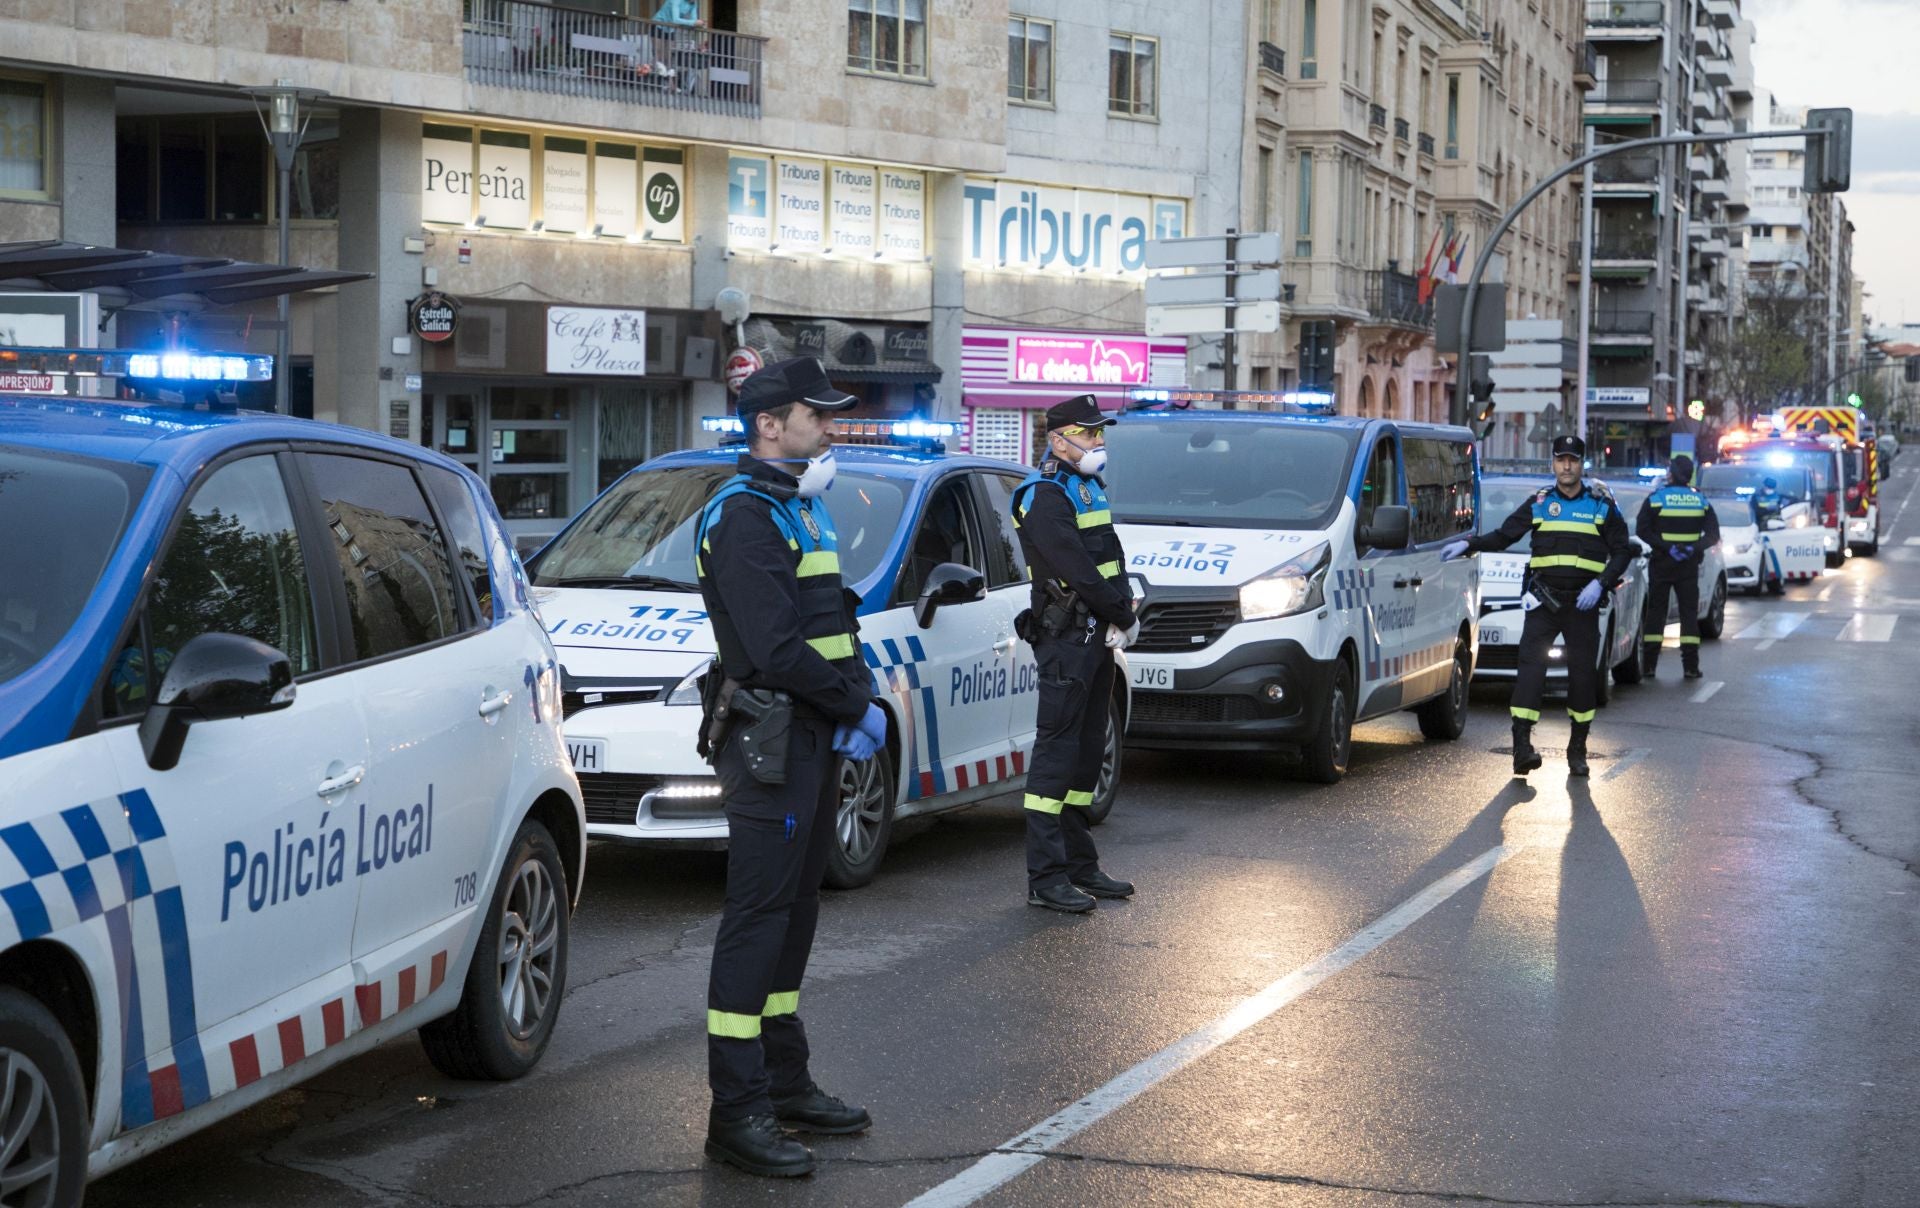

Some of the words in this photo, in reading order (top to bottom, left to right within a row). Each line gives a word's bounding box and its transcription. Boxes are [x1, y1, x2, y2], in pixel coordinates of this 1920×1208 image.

[425, 159, 526, 200] Pereña
[781, 164, 820, 181] Tribuna
[834, 170, 872, 186] Tribuna
[884, 174, 921, 191] Tribuna
[781, 194, 820, 211] Tribuna
[834, 200, 872, 216] Tribuna
[884, 204, 921, 220] Tribuna
[728, 223, 766, 238] Tribuna
[780, 226, 819, 241] Tribuna
[834, 231, 872, 246] Tribuna
[419, 307, 452, 319] Estrella
[420, 319, 451, 331] Galicia
[550, 310, 606, 346] Café
[570, 344, 641, 369] Plaza
[1018, 358, 1039, 381] La
[1042, 358, 1088, 382] dulce
[1263, 533, 1302, 543] 719
[1165, 540, 1237, 556] 112
[629, 606, 709, 625] 112
[950, 658, 1006, 707] Policía
[1011, 657, 1039, 694] Loc
[1134, 668, 1167, 685] JVG
[221, 810, 345, 922] Policía
[356, 783, 433, 876] Local
[454, 871, 476, 908] 708
